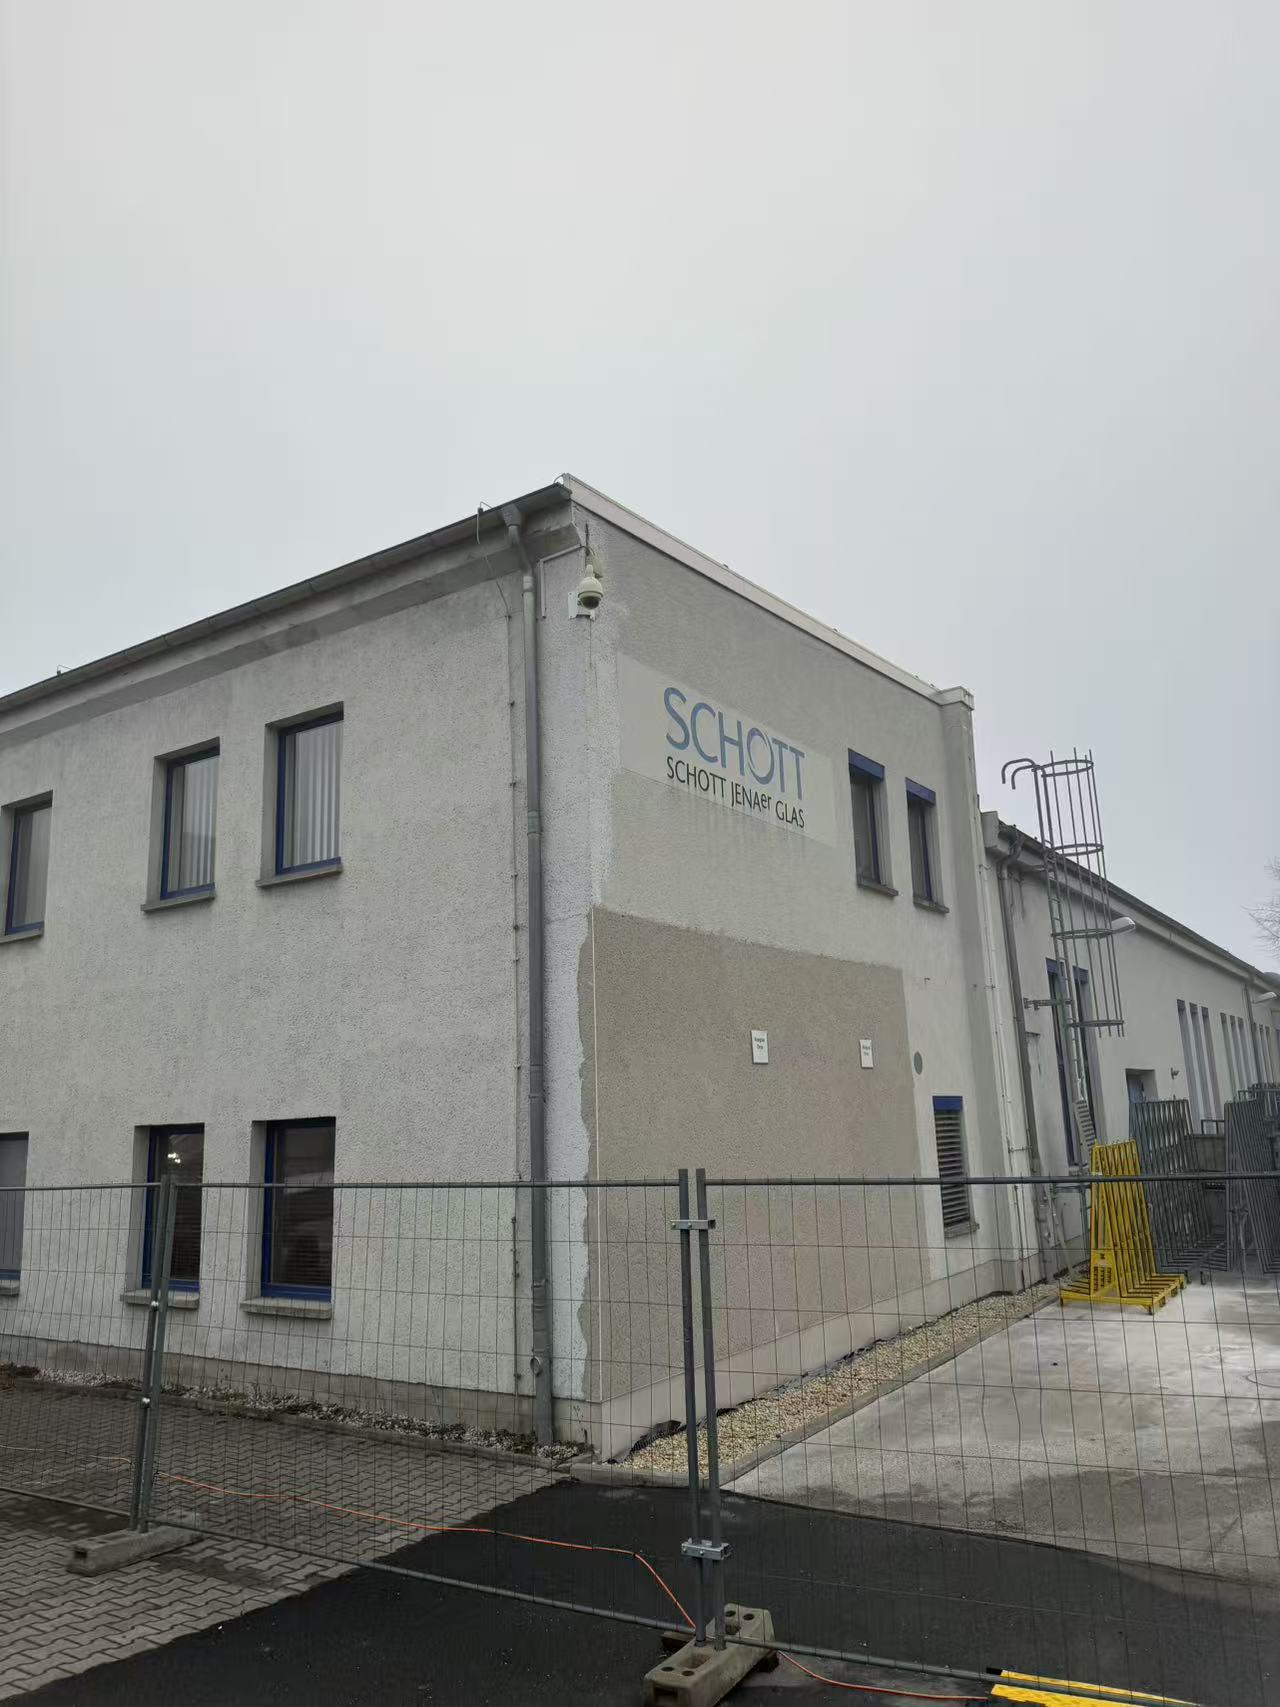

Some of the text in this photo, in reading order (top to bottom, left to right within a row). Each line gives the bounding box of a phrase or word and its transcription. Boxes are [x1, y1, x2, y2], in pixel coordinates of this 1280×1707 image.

[664, 687, 805, 800] SCHOTT
[666, 756, 727, 798] SCHOTT
[775, 801, 805, 828] GLAS
